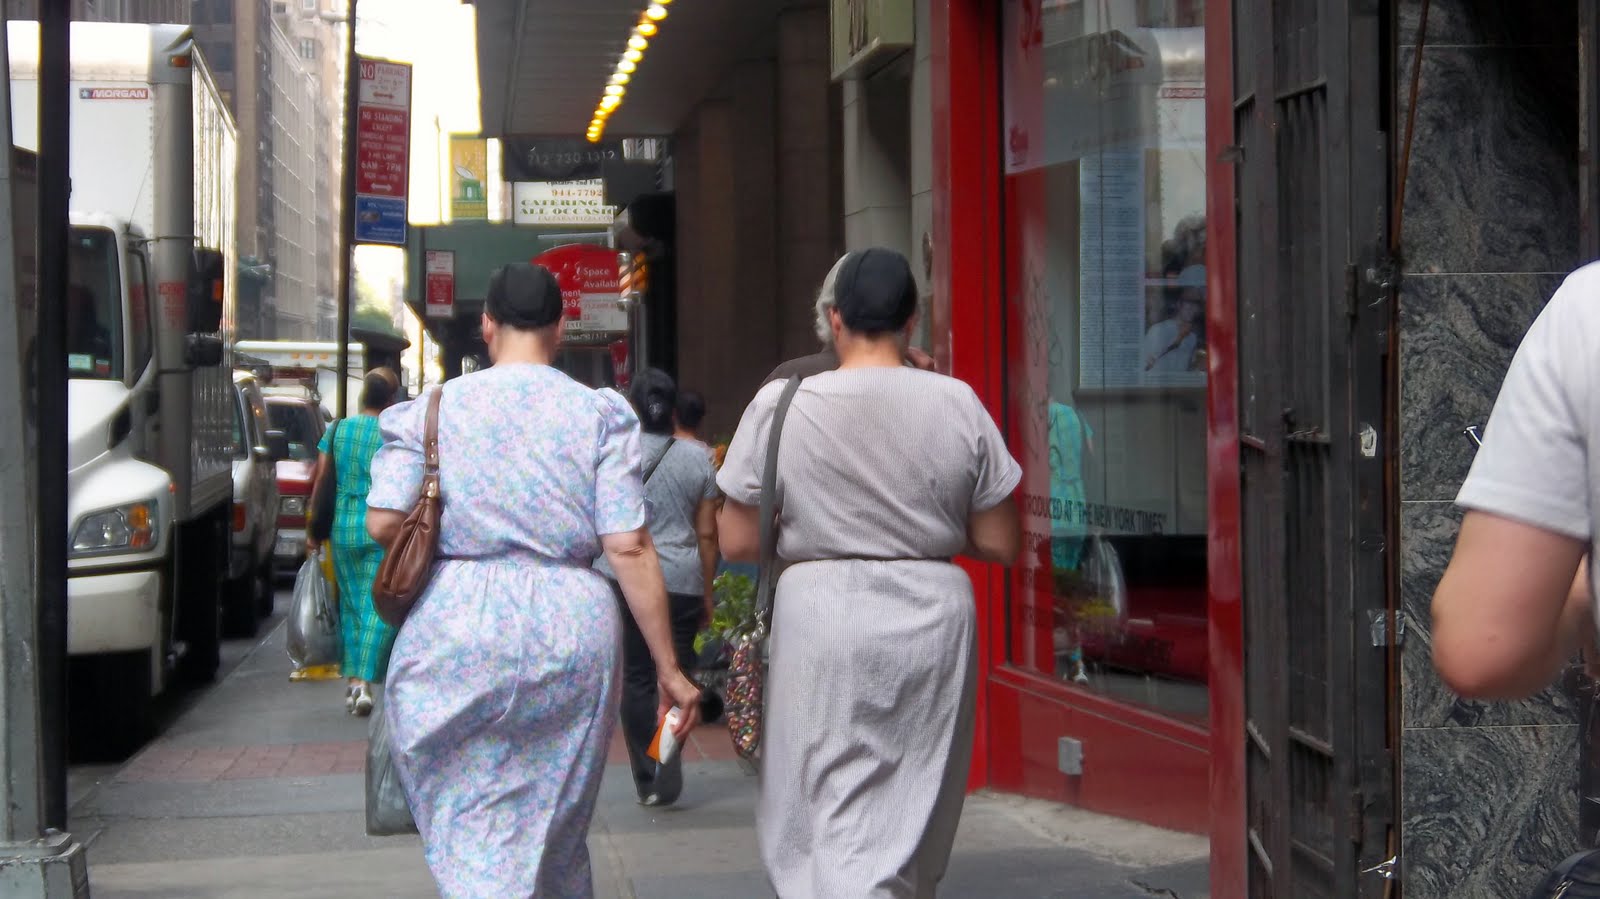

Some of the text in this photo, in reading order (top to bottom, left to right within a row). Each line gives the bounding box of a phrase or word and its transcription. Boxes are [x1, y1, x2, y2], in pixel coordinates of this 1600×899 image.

[360, 64, 374, 79] NO
[92, 89, 146, 98] MORGAN
[362, 110, 403, 123] NO STANDING
[583, 267, 610, 277] Space
[1064, 499, 1073, 522] AT
[1094, 503, 1114, 529] NEW
[1114, 506, 1136, 533] YORK
